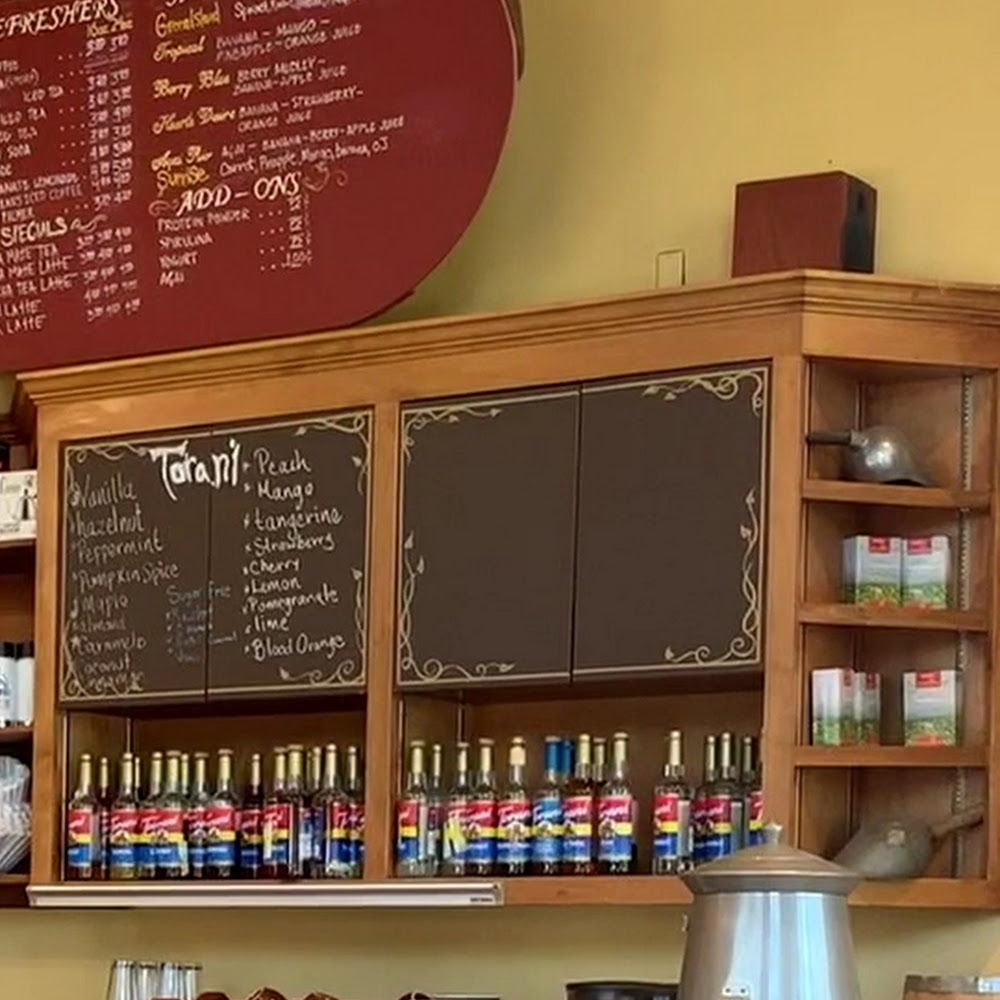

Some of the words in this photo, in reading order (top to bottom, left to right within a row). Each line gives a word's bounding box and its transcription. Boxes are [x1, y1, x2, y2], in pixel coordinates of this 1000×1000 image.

[149, 438, 241, 502] Torani
[254, 446, 312, 478] Peach
[252, 634, 294, 662] Blood
[296, 631, 347, 661] Orange
